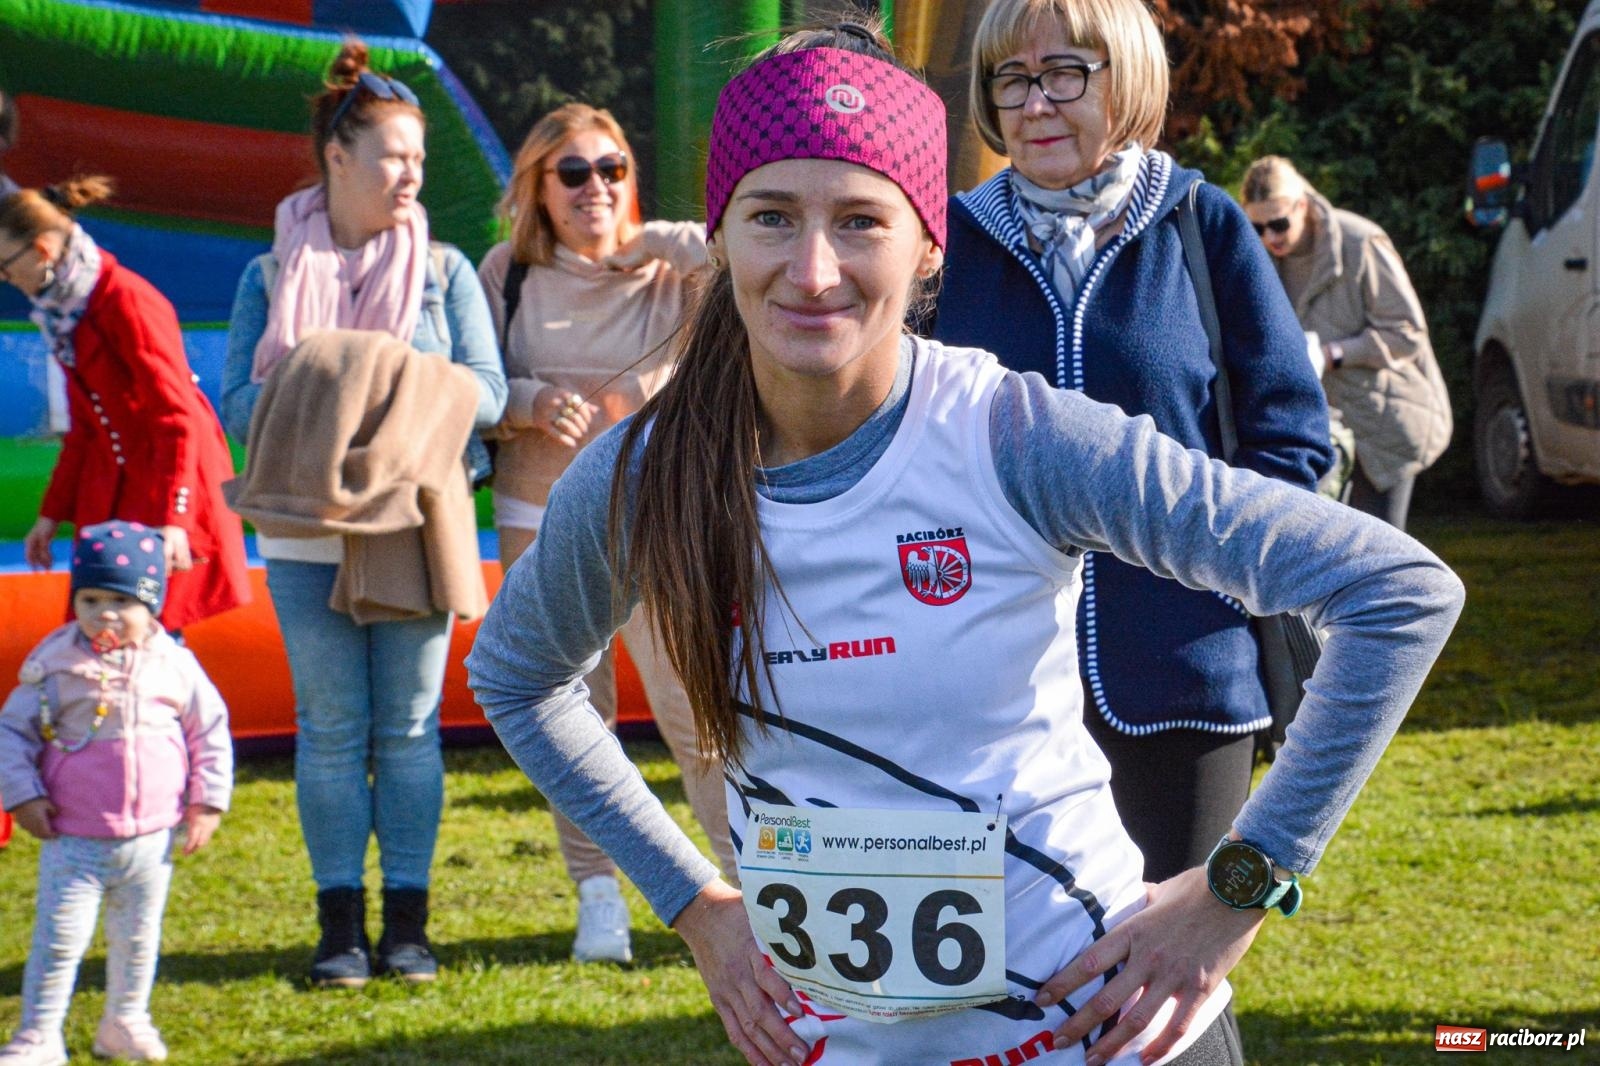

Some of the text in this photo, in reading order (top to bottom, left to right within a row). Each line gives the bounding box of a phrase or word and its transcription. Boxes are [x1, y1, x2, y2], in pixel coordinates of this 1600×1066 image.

[896, 527, 964, 544] RACIBÓRZ
[822, 834, 987, 854] www.personalbest.pl
[756, 882, 986, 987] 336
